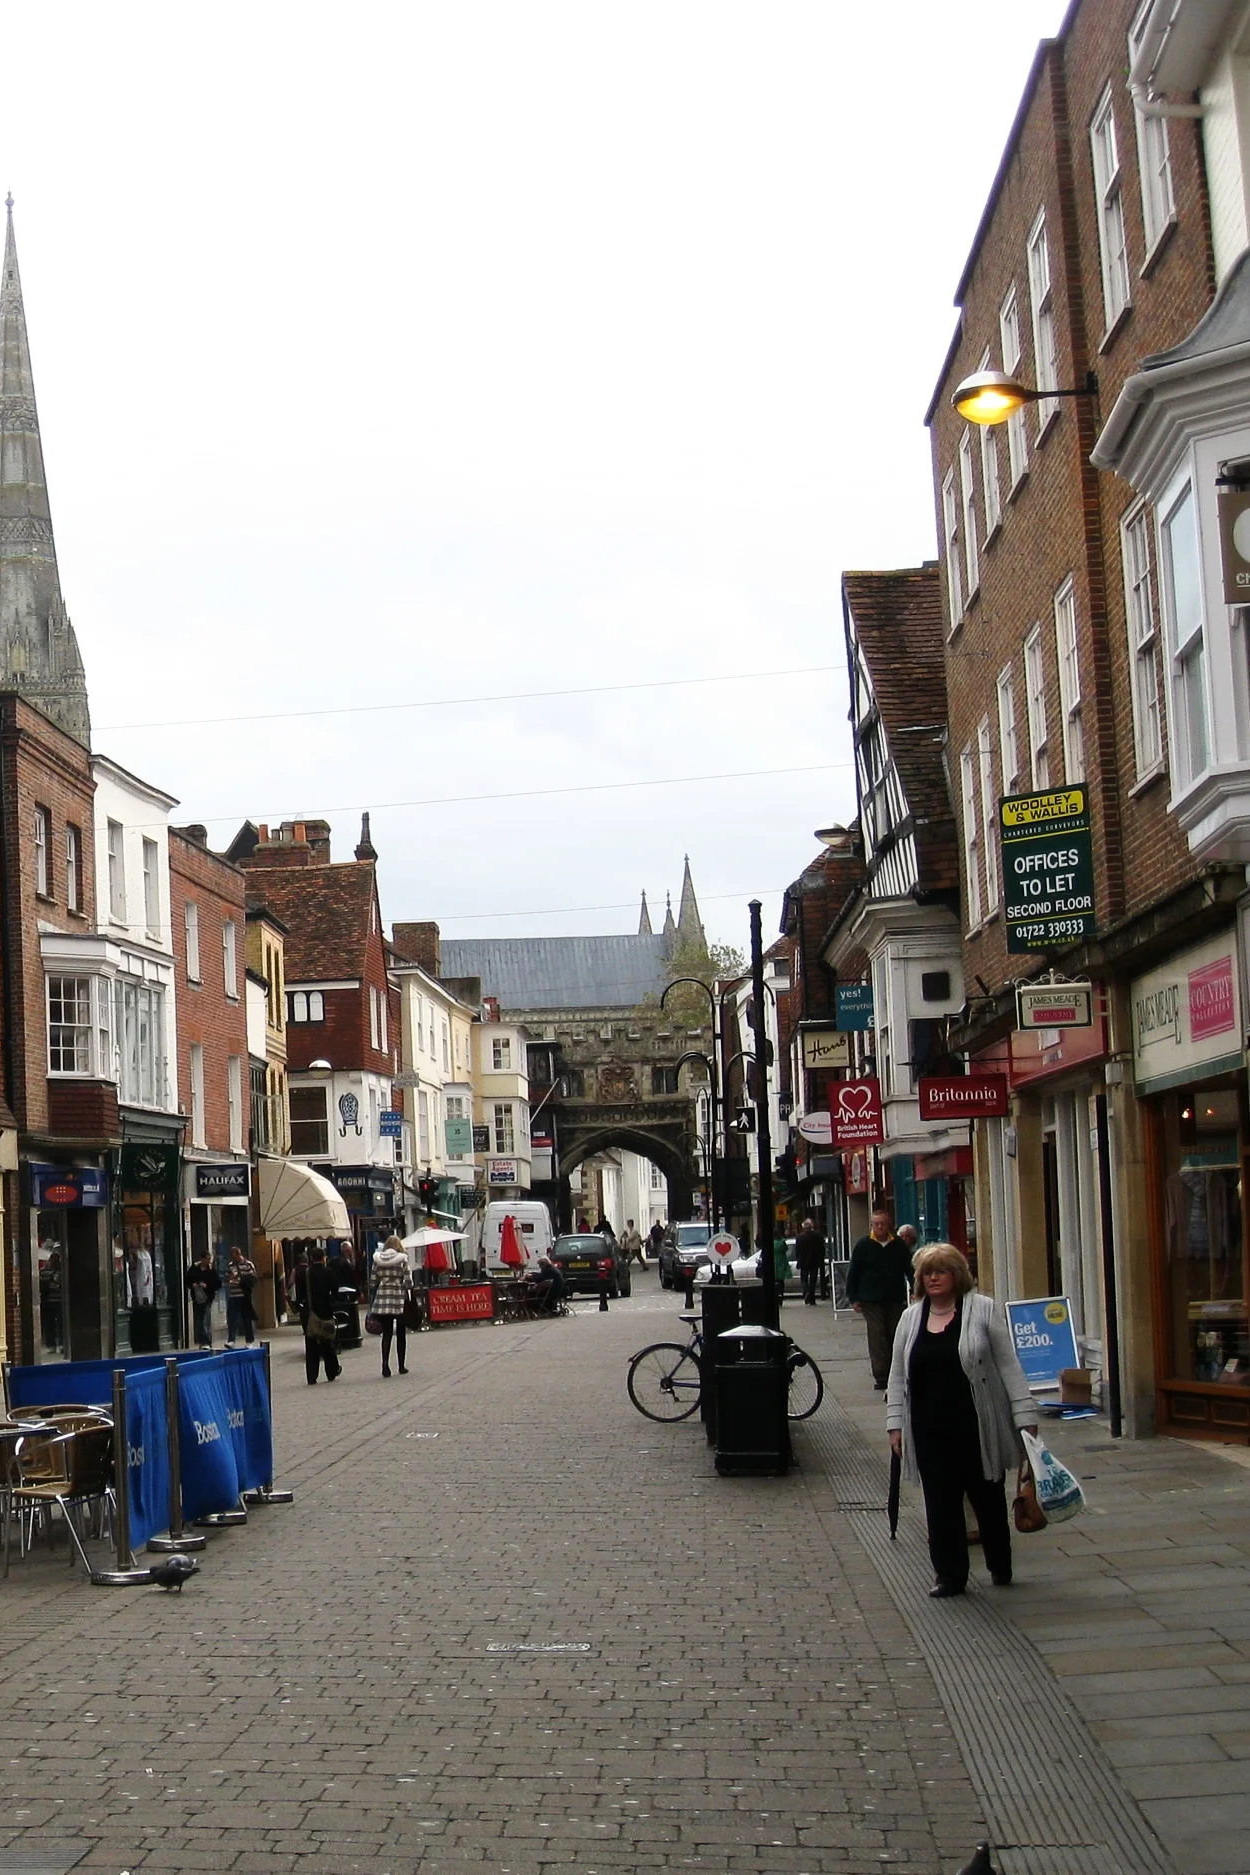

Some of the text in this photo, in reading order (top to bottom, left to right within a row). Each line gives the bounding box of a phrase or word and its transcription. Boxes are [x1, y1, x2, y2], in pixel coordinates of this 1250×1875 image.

[1008, 793, 1072, 813] WOOLLEY
[1015, 803, 1079, 822] & WALLIS
[1003, 819, 1085, 839] CHARTERED SURVEYORS
[1014, 848, 1079, 874] OFFICES
[1020, 873, 1075, 897] TO LET
[1006, 896, 1092, 919] SECOND FLOOR
[1016, 919, 1084, 940] 01722 330333
[840, 989, 862, 1000] yes!
[1191, 975, 1230, 1011] COUNTRY
[1028, 994, 1082, 1010] JAMES MEADE
[929, 1086, 998, 1103] Britannia
[837, 1130, 878, 1139] Foundation
[859, 1123, 878, 1131] Heart
[199, 1175, 245, 1187] HALIFAX
[432, 1292, 488, 1304] CREAM TEA
[430, 1305, 455, 1315] TIME
[456, 1304, 465, 1313] IS
[1014, 1321, 1037, 1335] Get
[1016, 1334, 1054, 1349] £200.
